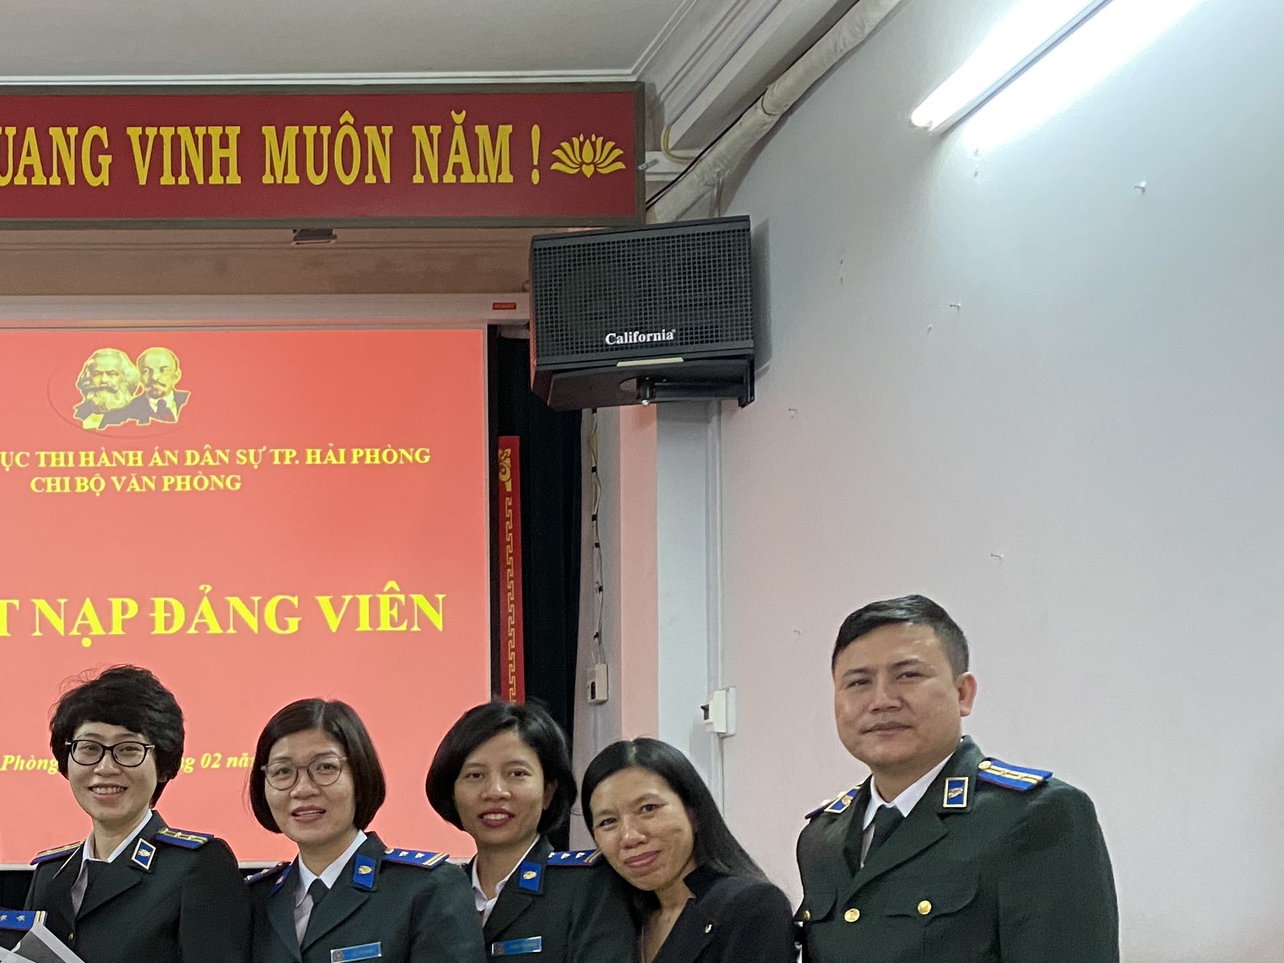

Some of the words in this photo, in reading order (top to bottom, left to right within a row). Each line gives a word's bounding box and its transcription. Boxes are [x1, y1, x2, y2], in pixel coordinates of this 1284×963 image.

[127, 125, 241, 186] VINH
[261, 110, 394, 186] MUÔN
[412, 109, 514, 185] NĂM
[605, 329, 676, 345] California
[35, 450, 75, 468] THI
[79, 446, 144, 467] HÀNH
[148, 446, 179, 467] ÁN
[184, 444, 231, 467] DÂN
[236, 446, 267, 469] SỰ
[269, 449, 300, 465] TP.
[305, 443, 346, 465] HẢI
[351, 444, 431, 465] PHÒNG
[30, 476, 71, 493] CHI
[75, 473, 106, 497] BỘ
[111, 474, 157, 493] VĂN
[162, 471, 242, 491] PHÒNG
[32, 597, 139, 648] NẠP
[151, 584, 303, 636] ĐẢNG
[315, 581, 447, 633] VIÊN
[200, 752, 222, 769] 02
